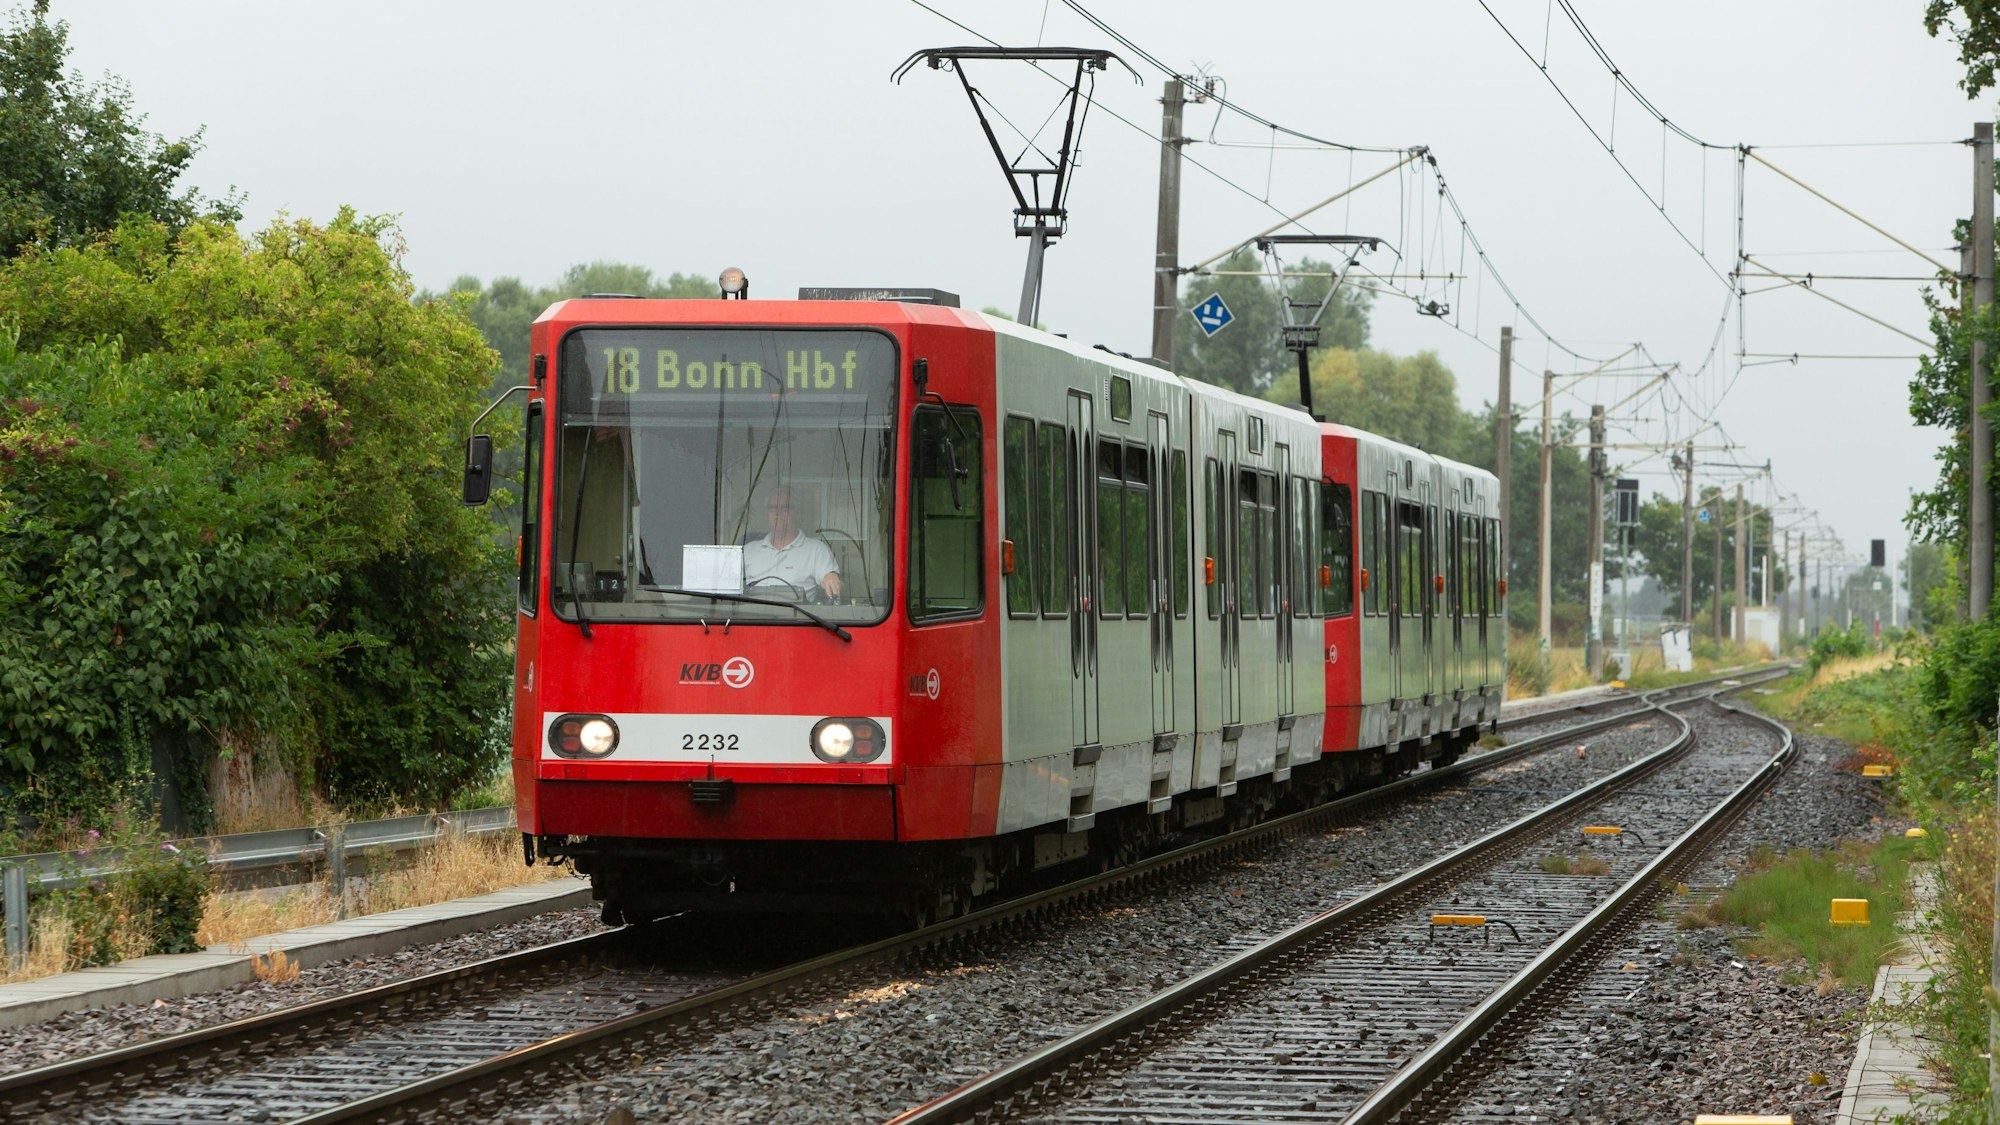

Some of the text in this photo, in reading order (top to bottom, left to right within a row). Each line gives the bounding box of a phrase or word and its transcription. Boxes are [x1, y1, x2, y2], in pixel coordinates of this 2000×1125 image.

[604, 347, 857, 393] 18 Bonn Hbf
[680, 663, 722, 681] KVB
[682, 734, 739, 750] 2232
